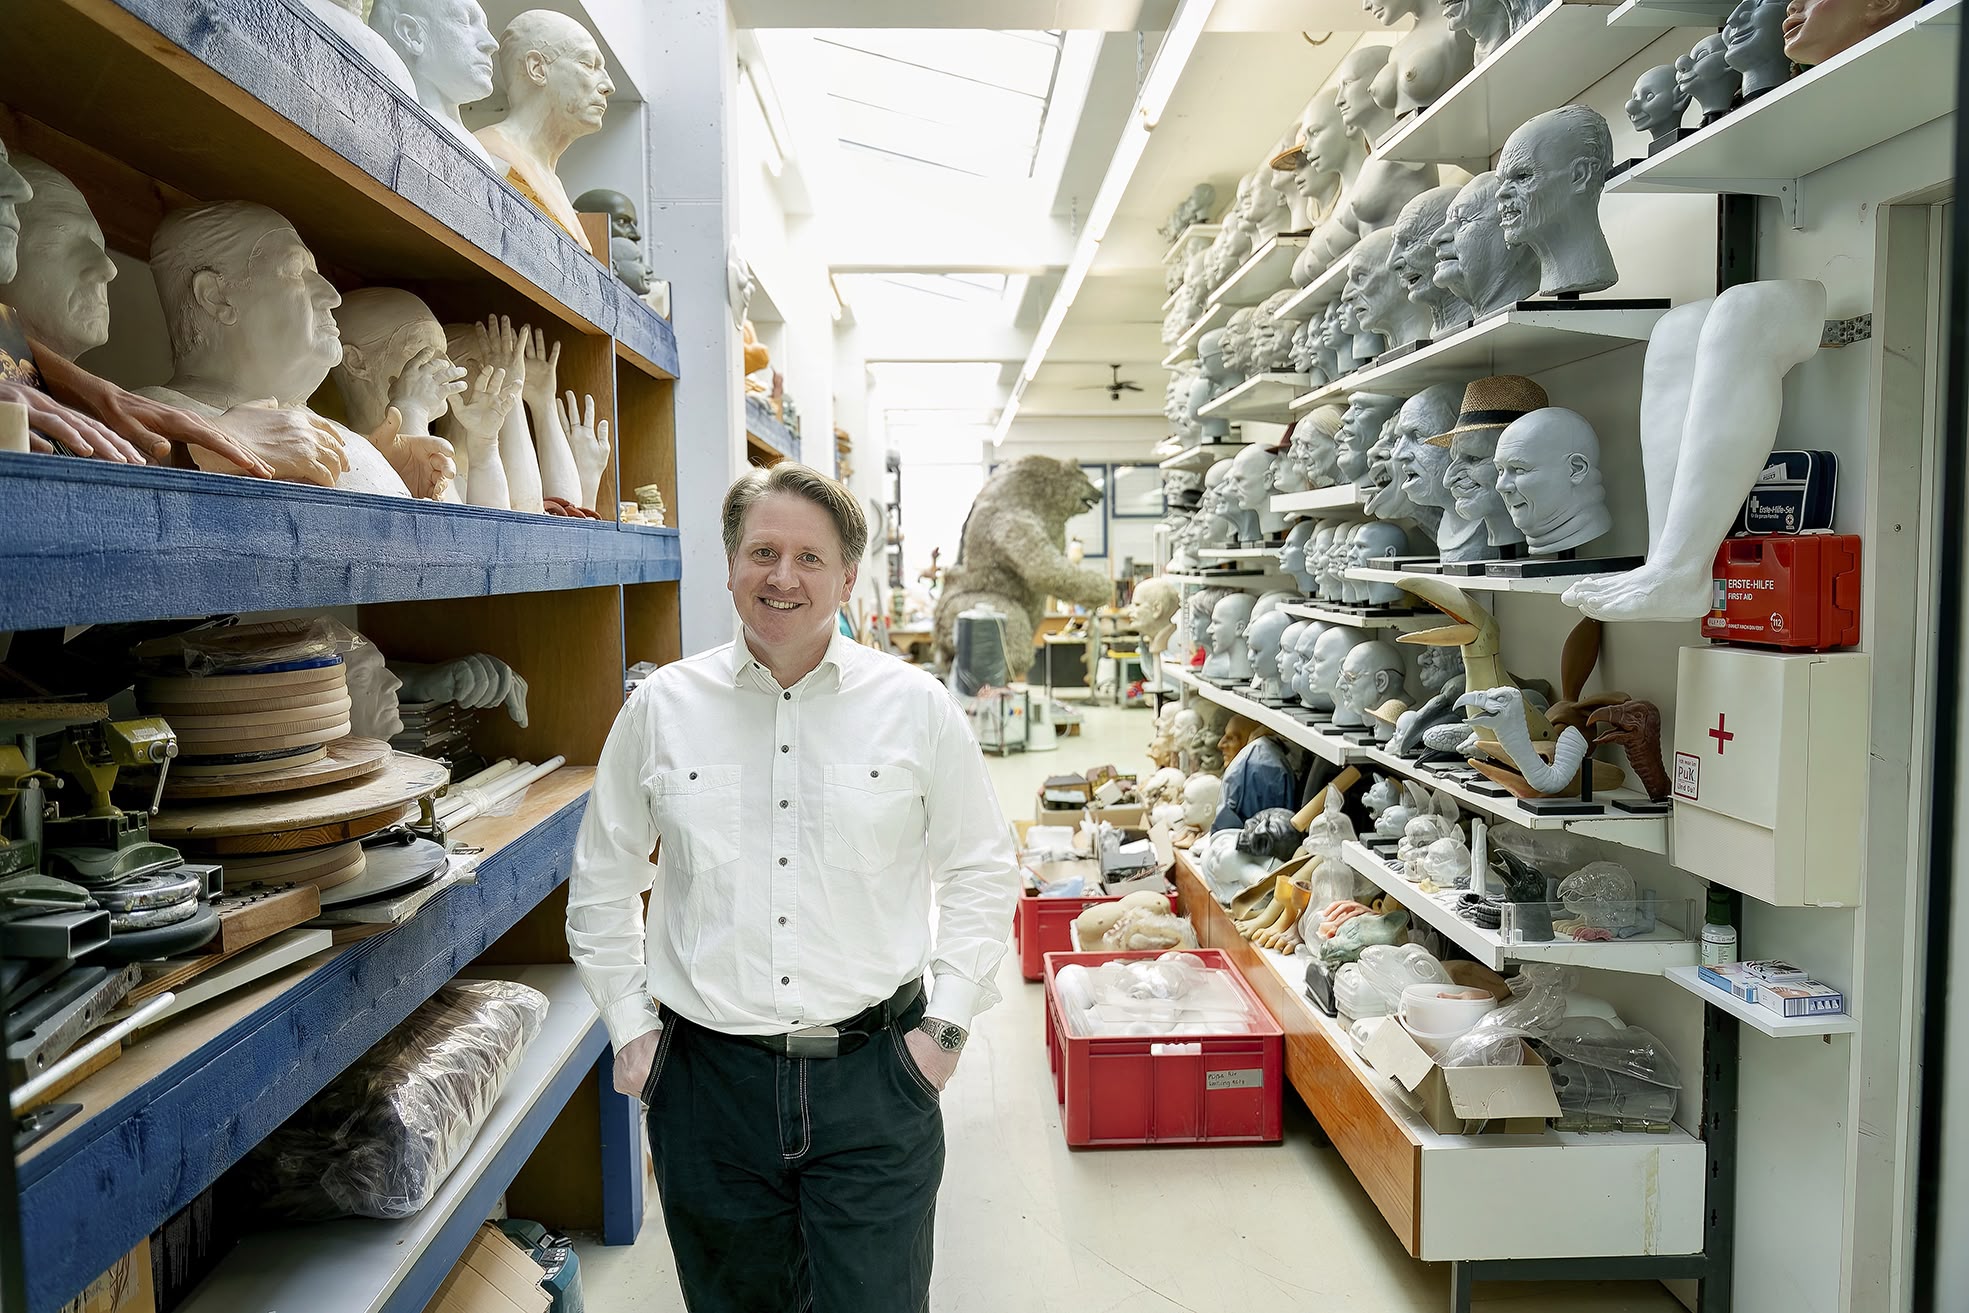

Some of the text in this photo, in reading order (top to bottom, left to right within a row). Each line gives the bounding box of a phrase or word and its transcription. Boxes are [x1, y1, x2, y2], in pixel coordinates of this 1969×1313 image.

[1728, 579, 1774, 590] ERSTE-HILFE
[1728, 592, 1753, 601] FIRST AID
[1772, 619, 1782, 627] 112
[1678, 766, 1694, 781] PuK
